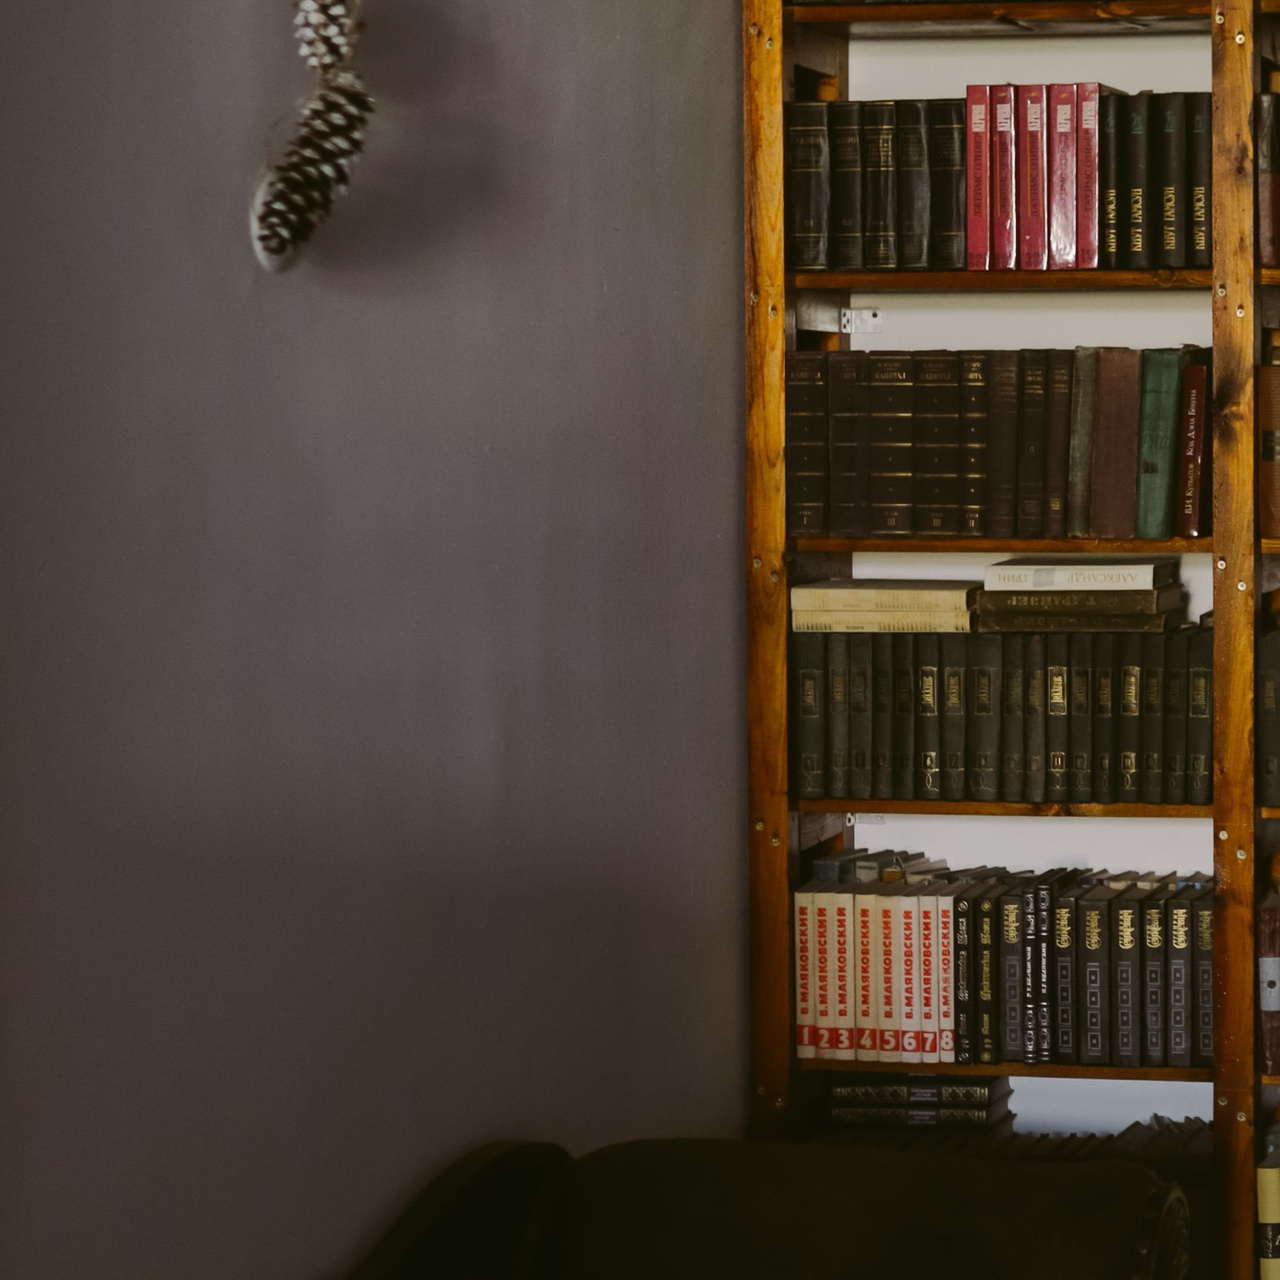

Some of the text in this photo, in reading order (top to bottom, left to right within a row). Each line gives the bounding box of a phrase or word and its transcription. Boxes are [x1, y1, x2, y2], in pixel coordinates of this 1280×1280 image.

[1105, 189, 1116, 224] ГАМСУН
[1131, 188, 1142, 223] ГАМСУН
[1164, 187, 1175, 221] ГАМСУН
[1193, 187, 1205, 221] ГАМСУН
[997, 573, 1137, 583] АЛЕКСАНДР ГРИН
[803, 1027, 809, 1045] 1
[818, 1029, 830, 1048] 2
[838, 1029, 849, 1048] 3
[860, 1030, 872, 1049] 4
[883, 1031, 895, 1049] 5
[903, 1032, 916, 1051] 6
[923, 1033, 934, 1051] 7
[941, 1031, 953, 1050] 8
